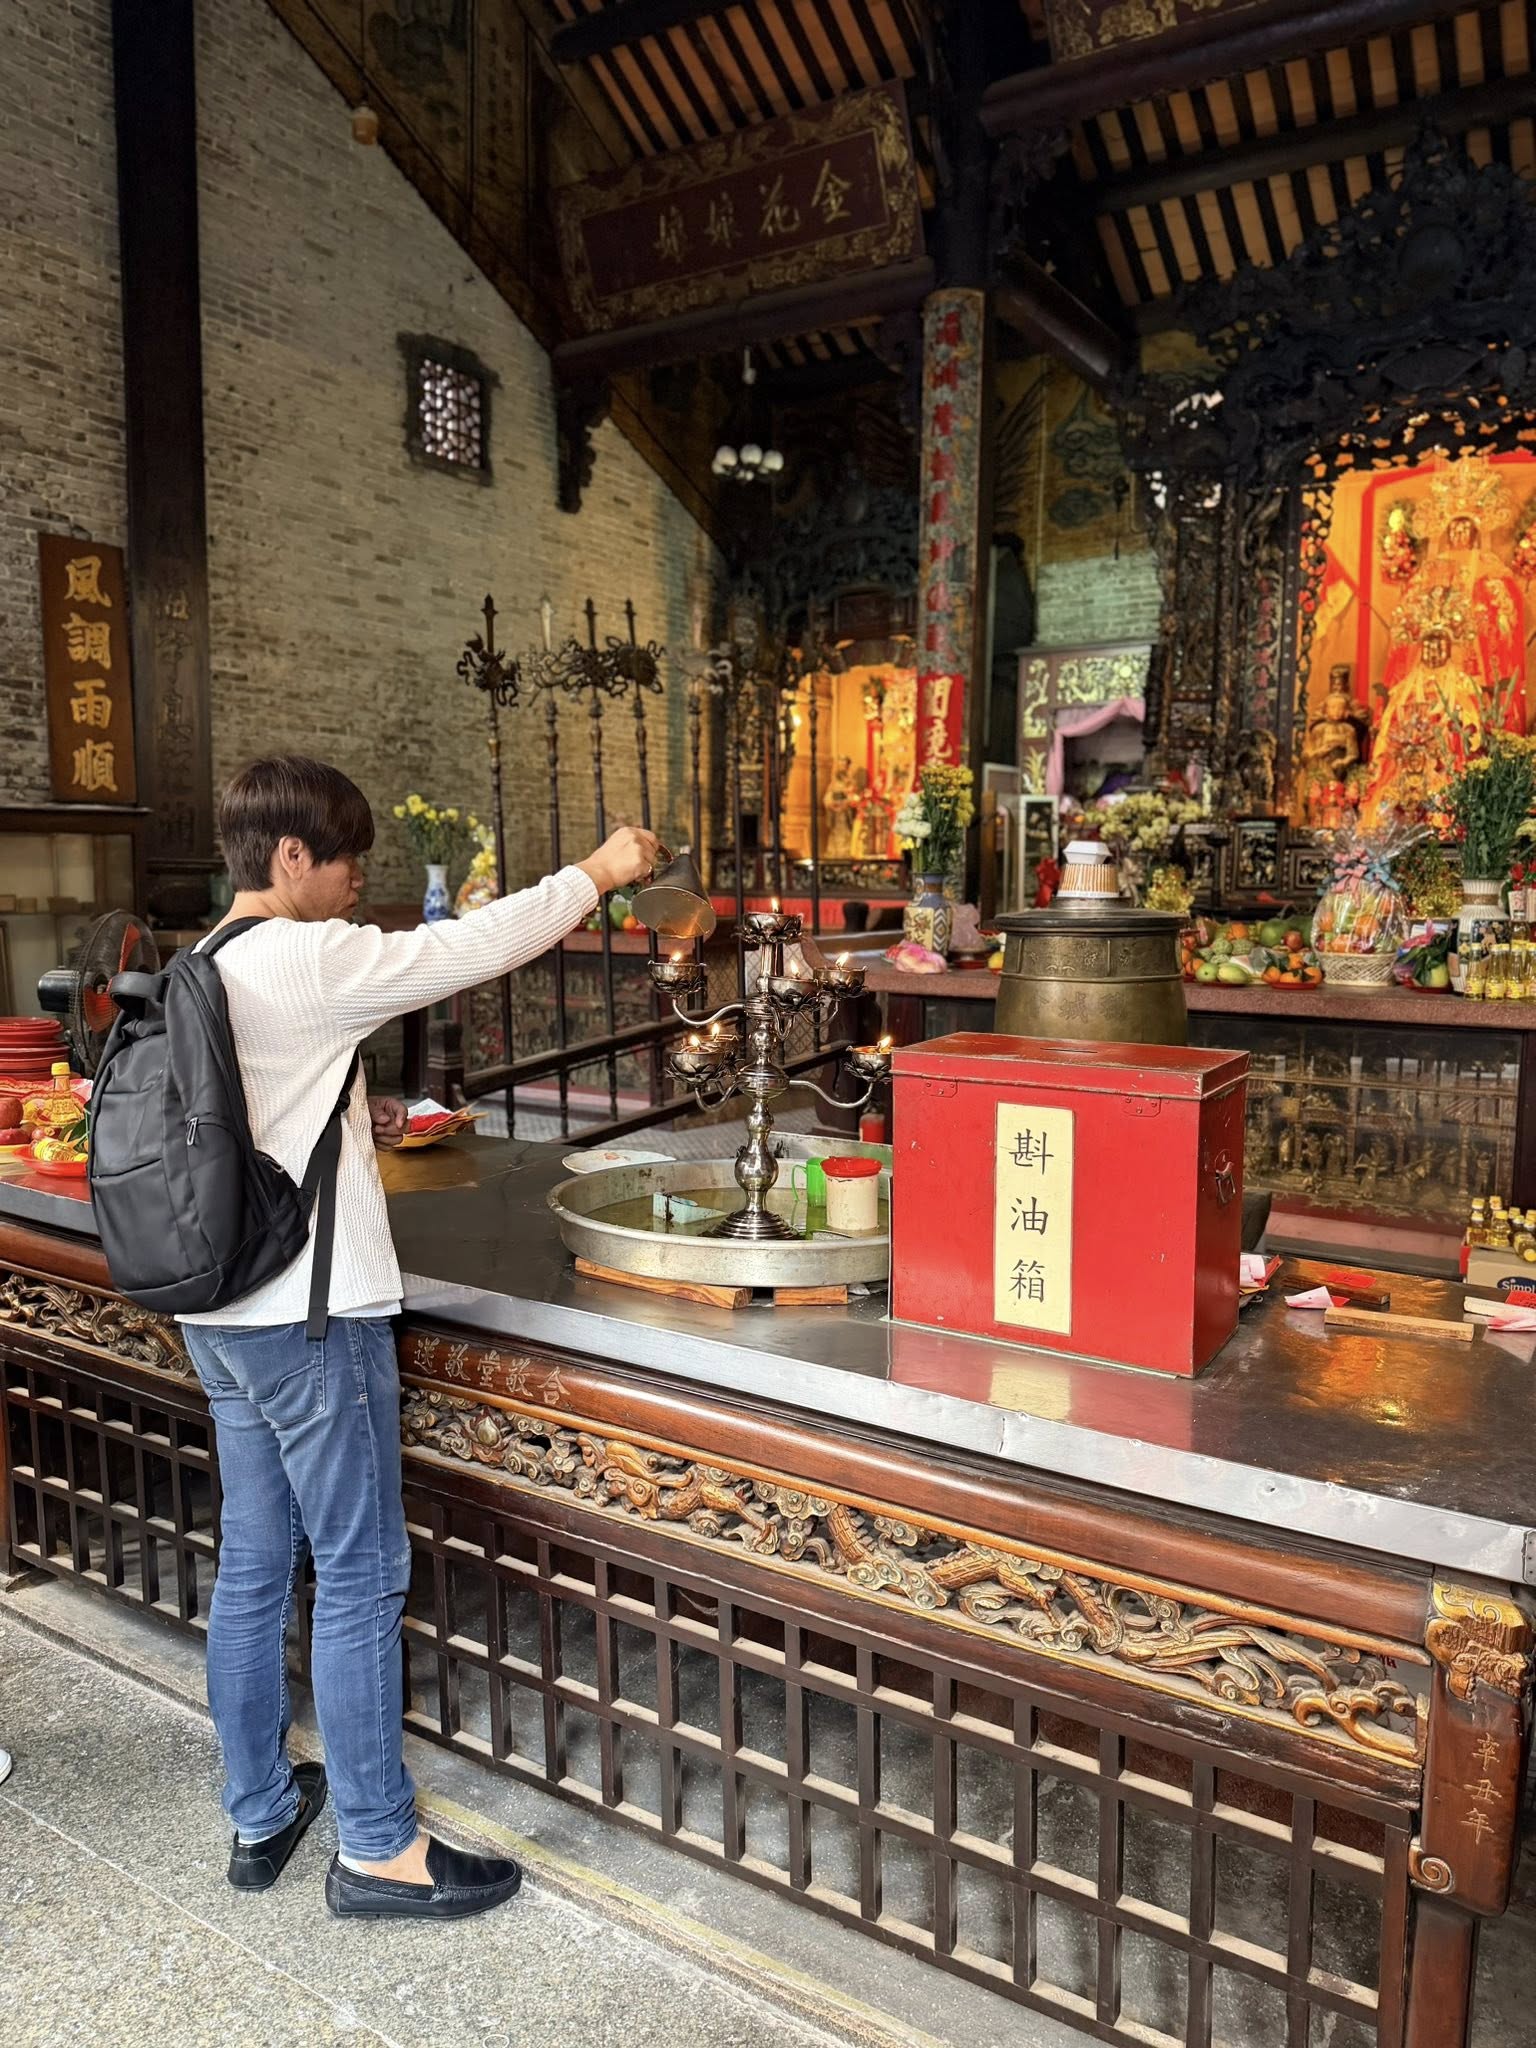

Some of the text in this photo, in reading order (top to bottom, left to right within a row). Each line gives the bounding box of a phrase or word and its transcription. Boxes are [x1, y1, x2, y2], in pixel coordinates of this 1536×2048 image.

[653, 158, 853, 264] 金花娘娘
[62, 555, 118, 792] 風調雨順
[1008, 1128, 1055, 1303] 斟油箱
[1460, 1732, 1503, 1845] 辛丑年
